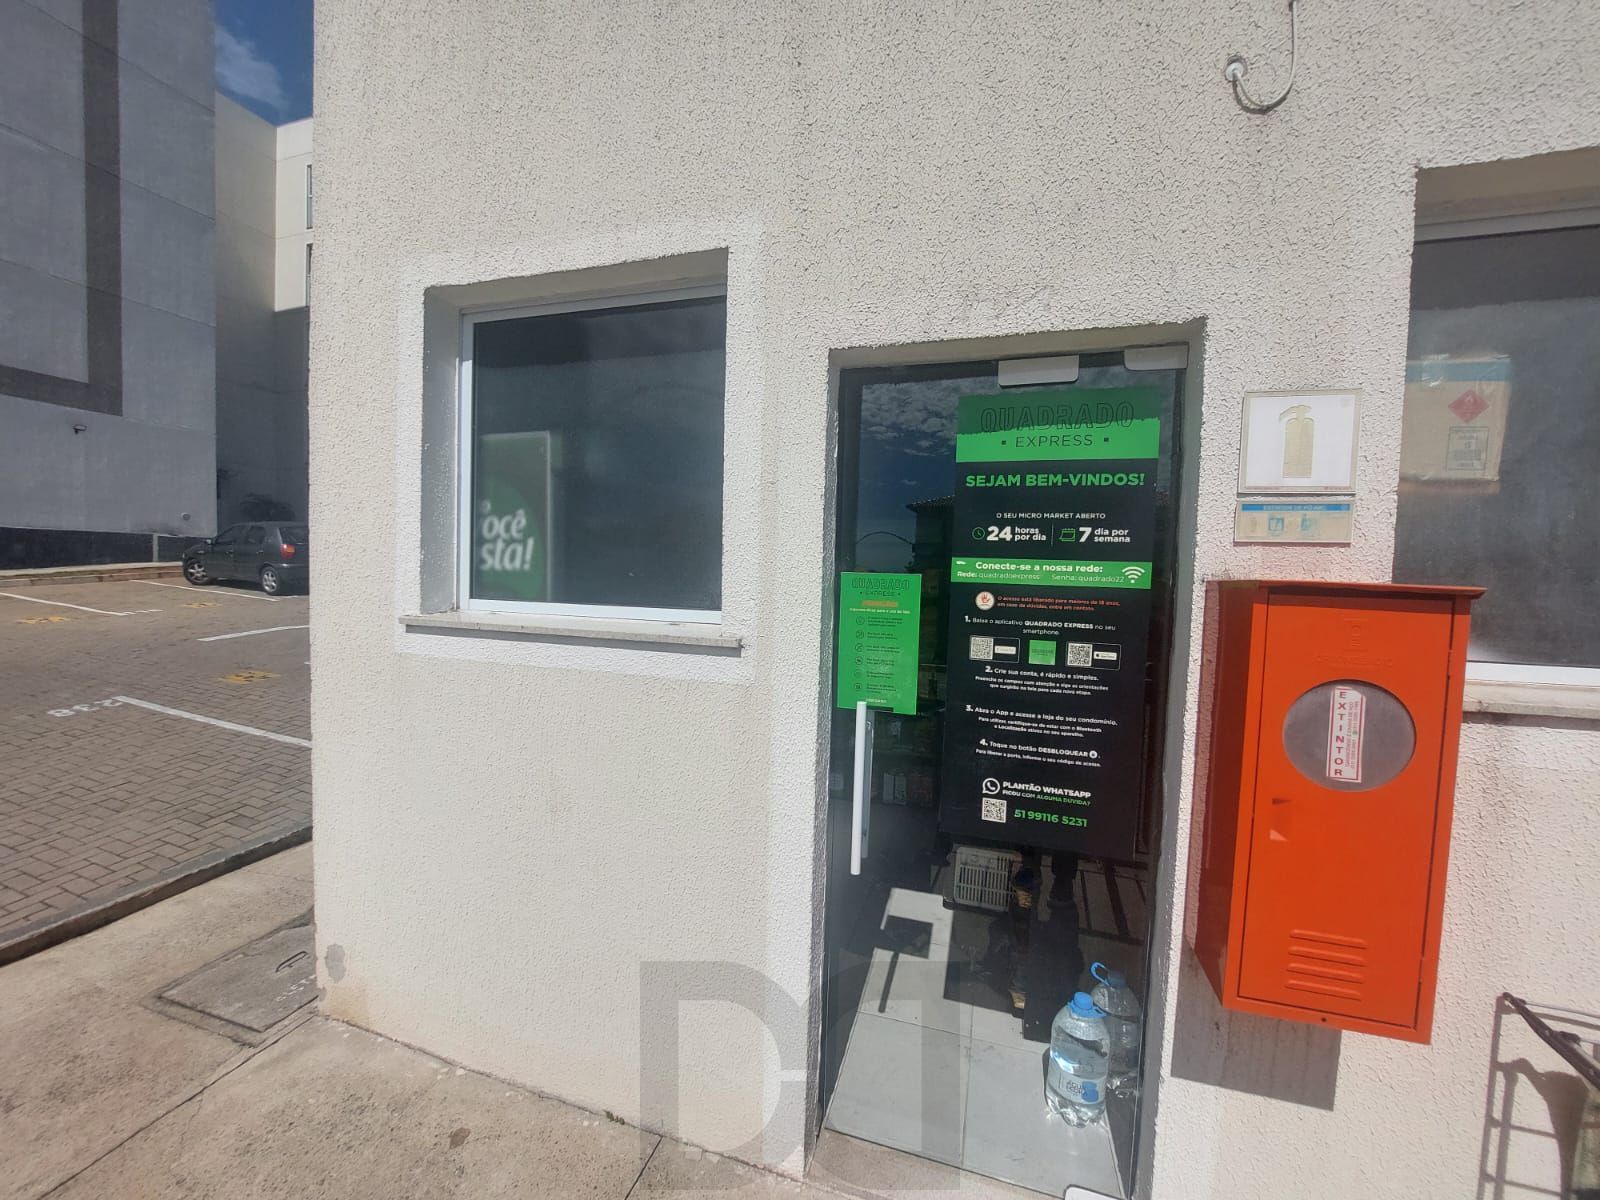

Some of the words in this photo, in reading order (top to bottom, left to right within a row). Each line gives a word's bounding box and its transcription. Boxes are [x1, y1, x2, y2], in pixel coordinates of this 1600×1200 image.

[981, 401, 1134, 433] QUADRADO
[1015, 435, 1093, 448] EXPRESS
[965, 474, 1021, 487] SEJAM
[1025, 473, 1145, 487] BEM-VINDOS!
[480, 508, 527, 540] ocê
[986, 526, 1013, 541] 24
[1015, 526, 1039, 534] horas
[1014, 534, 1031, 542] por
[1033, 533, 1047, 541] dia
[1079, 527, 1092, 542] 7
[1094, 528, 1109, 536] dia
[1111, 529, 1129, 537] por
[480, 536, 535, 571] sta!
[975, 561, 1031, 571] Conecte-se
[1042, 564, 1073, 572] nossa
[1075, 563, 1103, 573] rede:
[957, 570, 978, 578] Rede:
[1051, 573, 1077, 581] Senha:
[1078, 574, 1125, 584] quadrado22
[965, 615, 971, 623] 1.
[1024, 620, 1063, 628] QUADRADO
[1064, 622, 1094, 630] EXPRESS
[985, 665, 993, 673] 2.
[1334, 691, 1348, 776] EXTINTOR
[979, 738, 989, 746] 4.
[1038, 747, 1089, 757] DESBLOQUEAR
[1002, 781, 1042, 792] PLANTÃO
[1042, 786, 1092, 799] WHATSAPP
[1002, 789, 1021, 797] FICOU
[1014, 809, 1026, 819] 51
[1027, 811, 1059, 823] 99116
[1061, 816, 1088, 828] 5231
